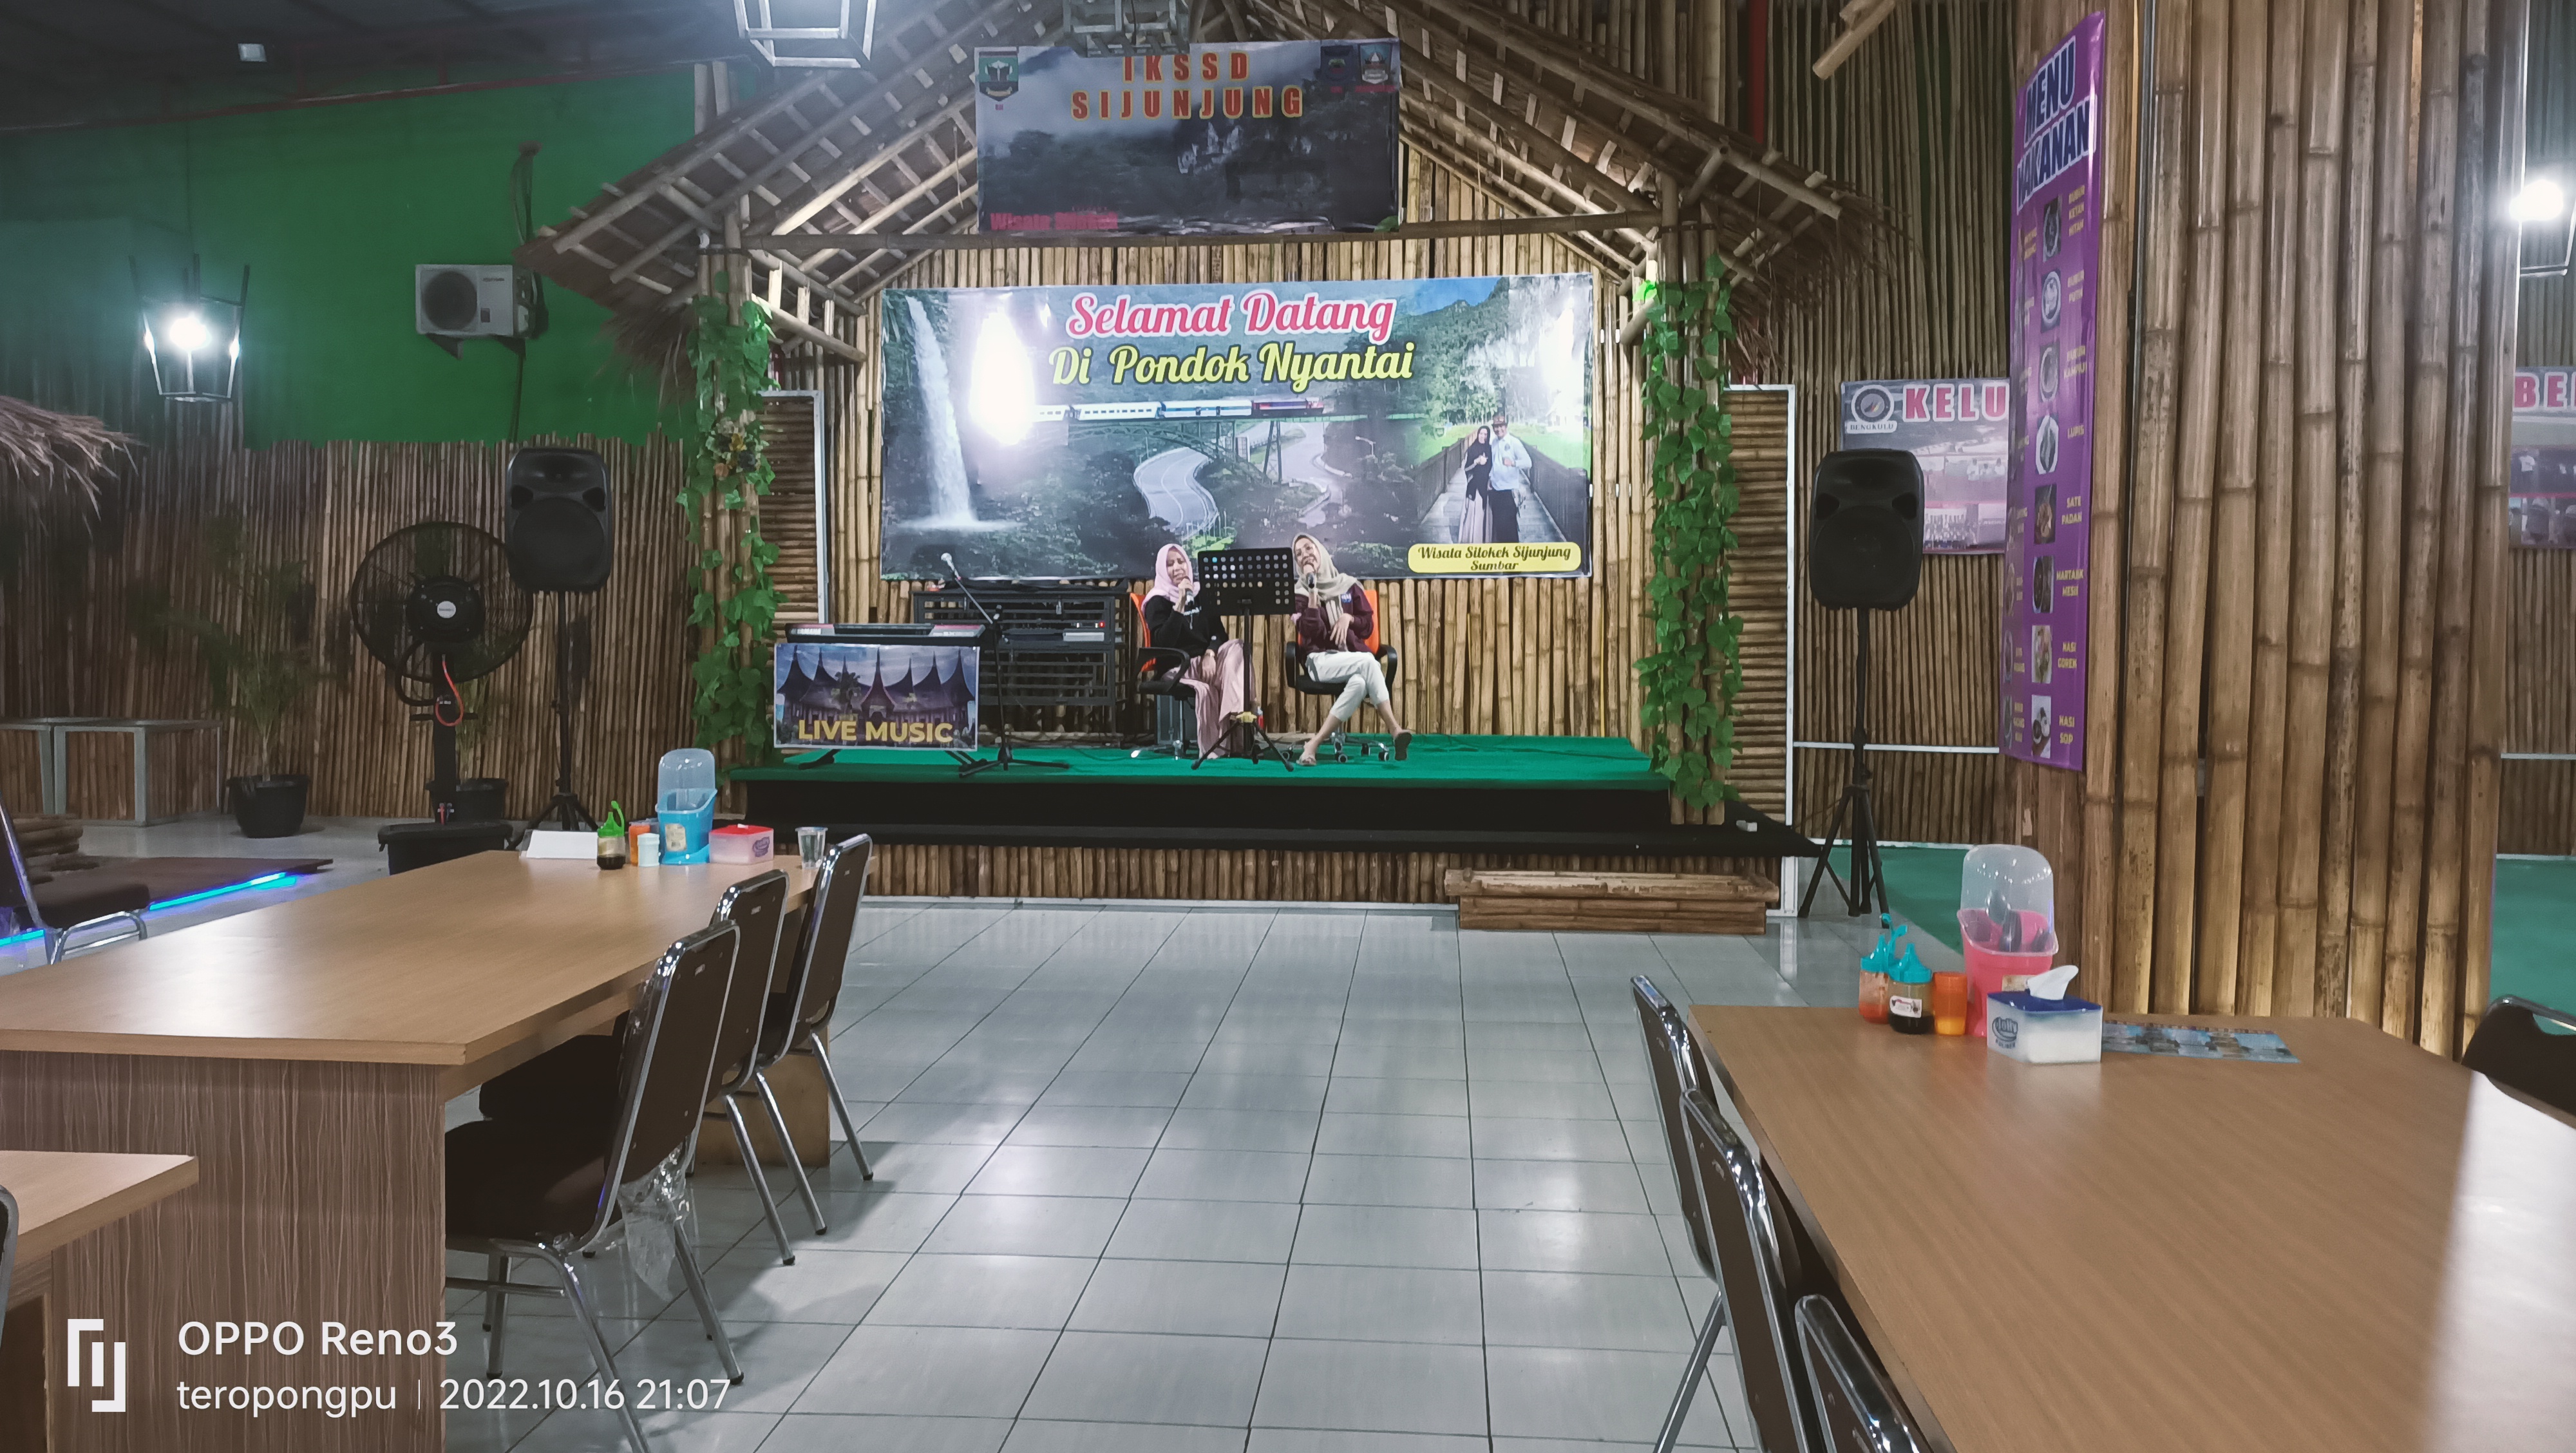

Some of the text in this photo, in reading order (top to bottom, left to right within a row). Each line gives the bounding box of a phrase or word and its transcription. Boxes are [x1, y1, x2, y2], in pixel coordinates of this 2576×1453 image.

[1122, 51, 1250, 82] IKSSD
[1070, 86, 1303, 120] SIJUNJUNG
[2024, 35, 2076, 148] MENU
[2016, 93, 2098, 215] MAKANAN
[1066, 289, 1397, 345] Selamat Datang
[1048, 341, 1416, 393] Di Pondok Nyantai
[1902, 383, 2009, 423] KELU
[2513, 371, 2576, 411] BE
[1850, 423, 1895, 431] BENGKULU
[1418, 545, 1571, 561] Wisata Silokek Sijunjung
[1471, 560, 1519, 571] Sumbar
[799, 719, 953, 743] LIVE MUSIC
